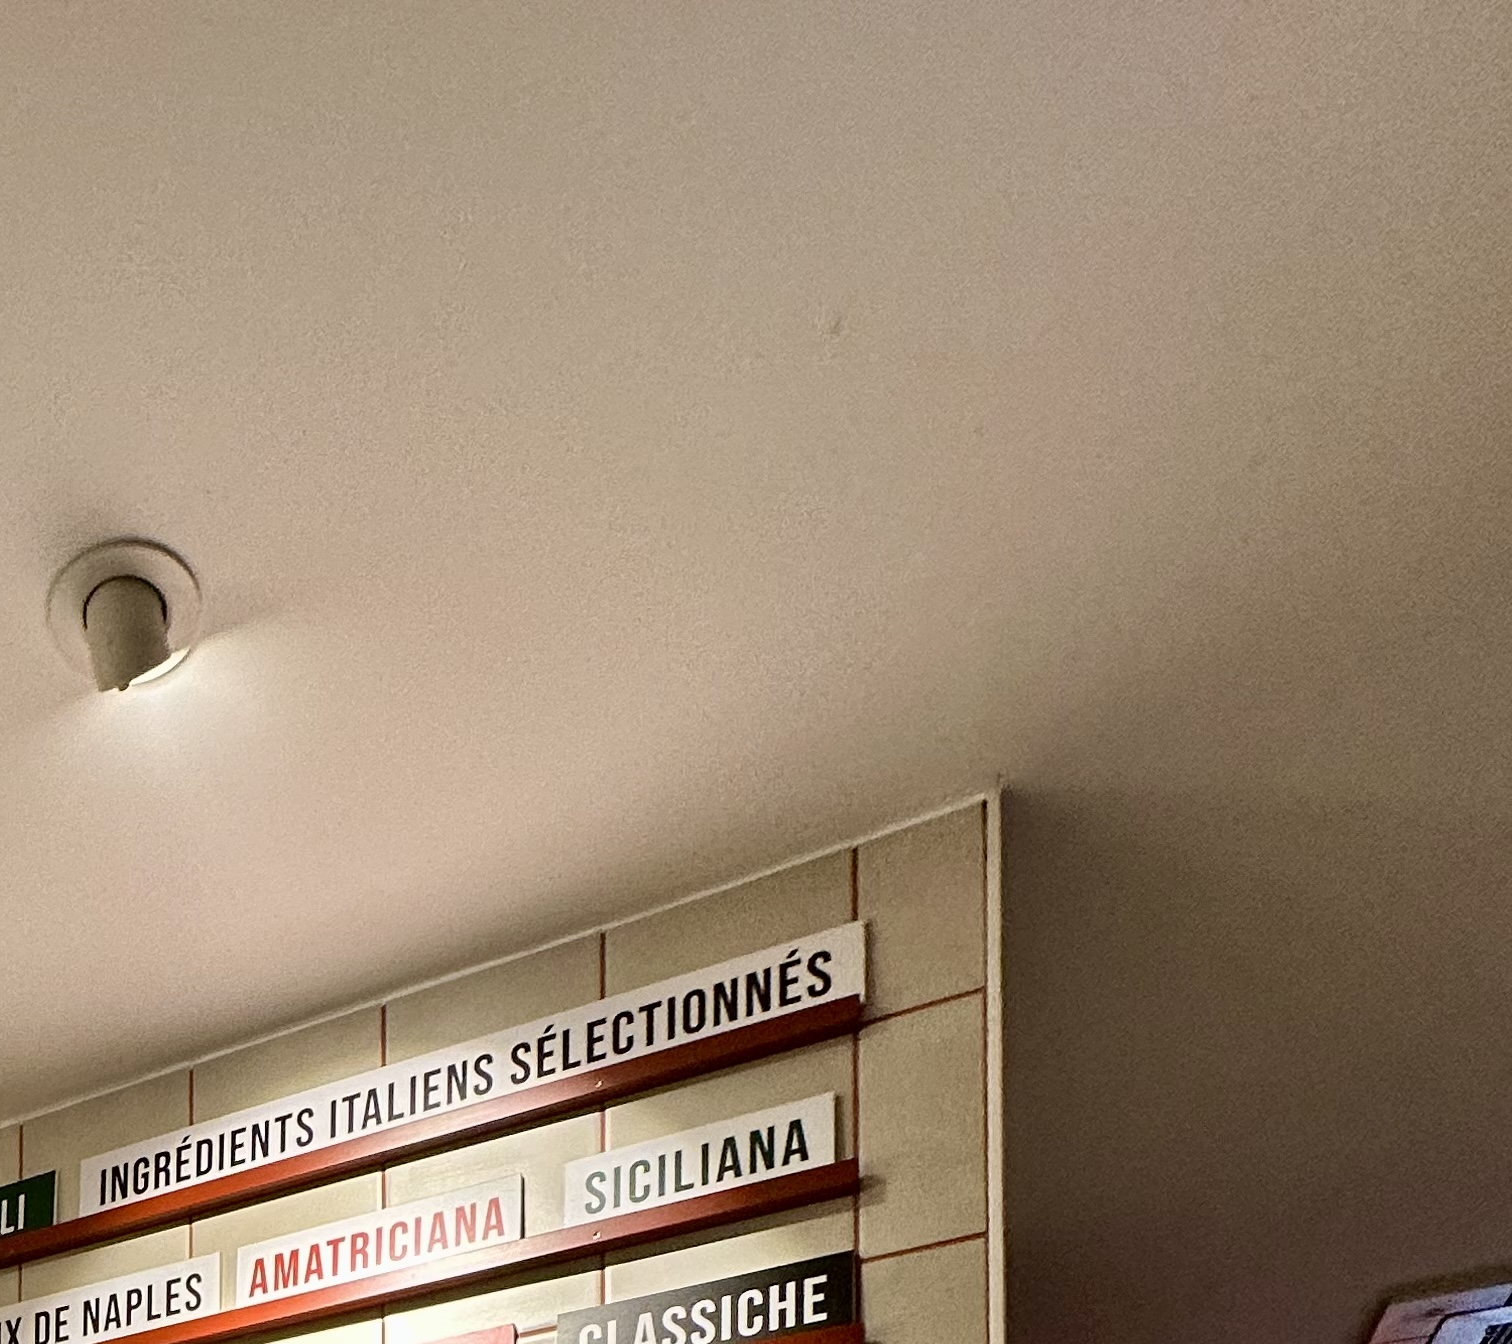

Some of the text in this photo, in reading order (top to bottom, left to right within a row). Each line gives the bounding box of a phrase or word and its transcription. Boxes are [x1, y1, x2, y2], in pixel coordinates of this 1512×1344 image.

[99, 947, 834, 1204] INGRÉDIENTS ITALIENS SÉLECTIONNÉS
[584, 1117, 810, 1216] SICILIANA
[248, 1195, 505, 1299] AMATRICIANA
[82, 1272, 203, 1338] NAPLES
